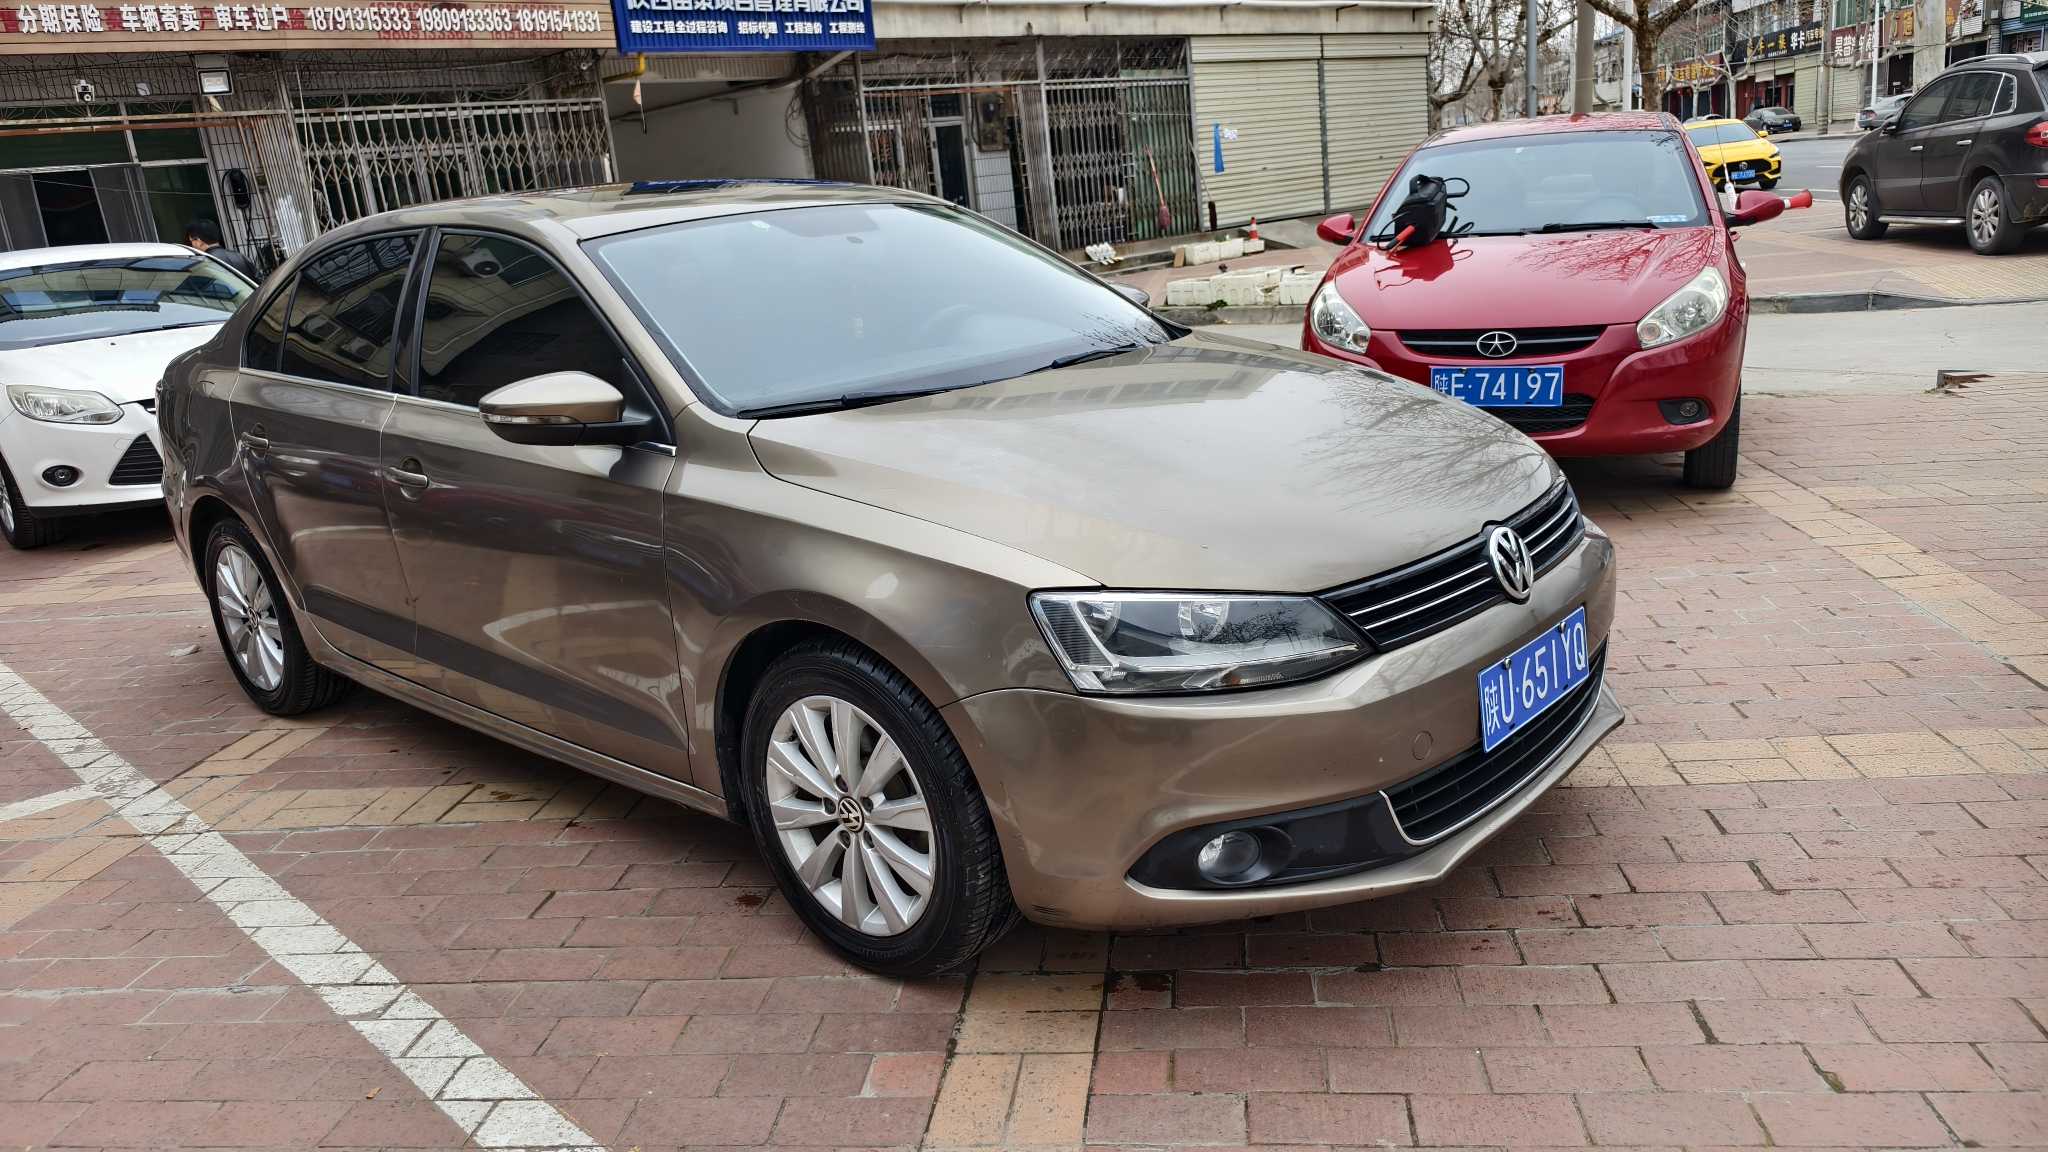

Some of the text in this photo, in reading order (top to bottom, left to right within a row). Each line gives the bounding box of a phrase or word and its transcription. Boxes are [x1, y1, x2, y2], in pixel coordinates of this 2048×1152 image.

[18, 4, 104, 34] 分期保险
[119, 4, 201, 32] 车辆寄卖
[214, 3, 289, 32] 审车过户
[307, 7, 411, 32] 18791315333
[416, 8, 512, 32] 19809133363
[517, 9, 601, 32] 18191541331
[630, 20, 729, 34] 建设工程全过程咨询
[737, 20, 779, 35] 招标代理
